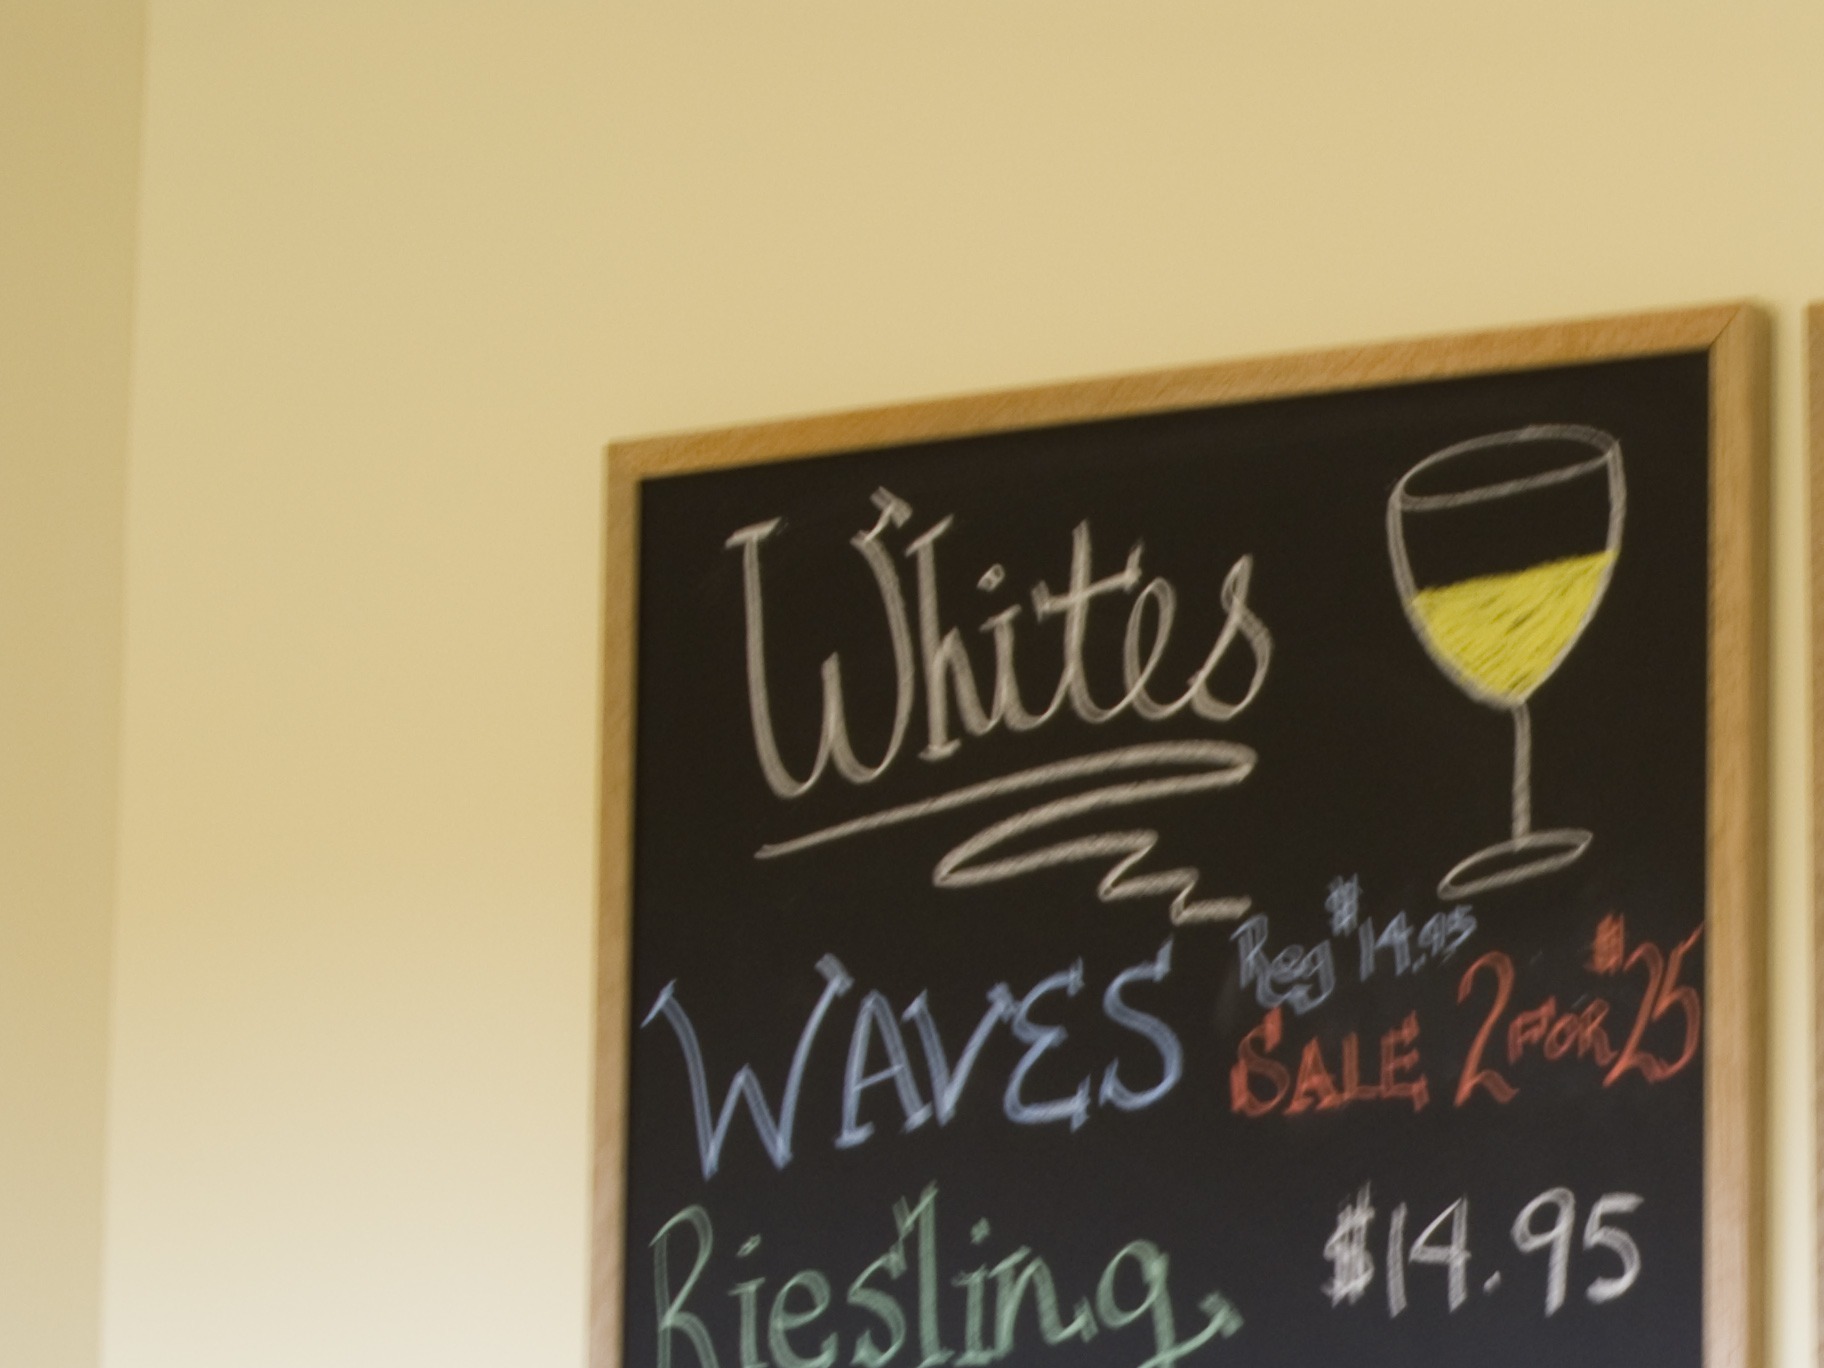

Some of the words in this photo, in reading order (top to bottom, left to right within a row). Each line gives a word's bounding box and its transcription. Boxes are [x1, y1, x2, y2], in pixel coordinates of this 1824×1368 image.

[727, 487, 1272, 797] Whites
[641, 938, 1183, 1180] WAVES
[1229, 1006, 1429, 1117] SALE
[1454, 951, 1519, 1108] 2
[1507, 996, 1618, 1066] FOR
[1592, 913, 1704, 1088] $25
[1231, 913, 1335, 1014] Reg
[1323, 1183, 1643, 1319] $14.95
